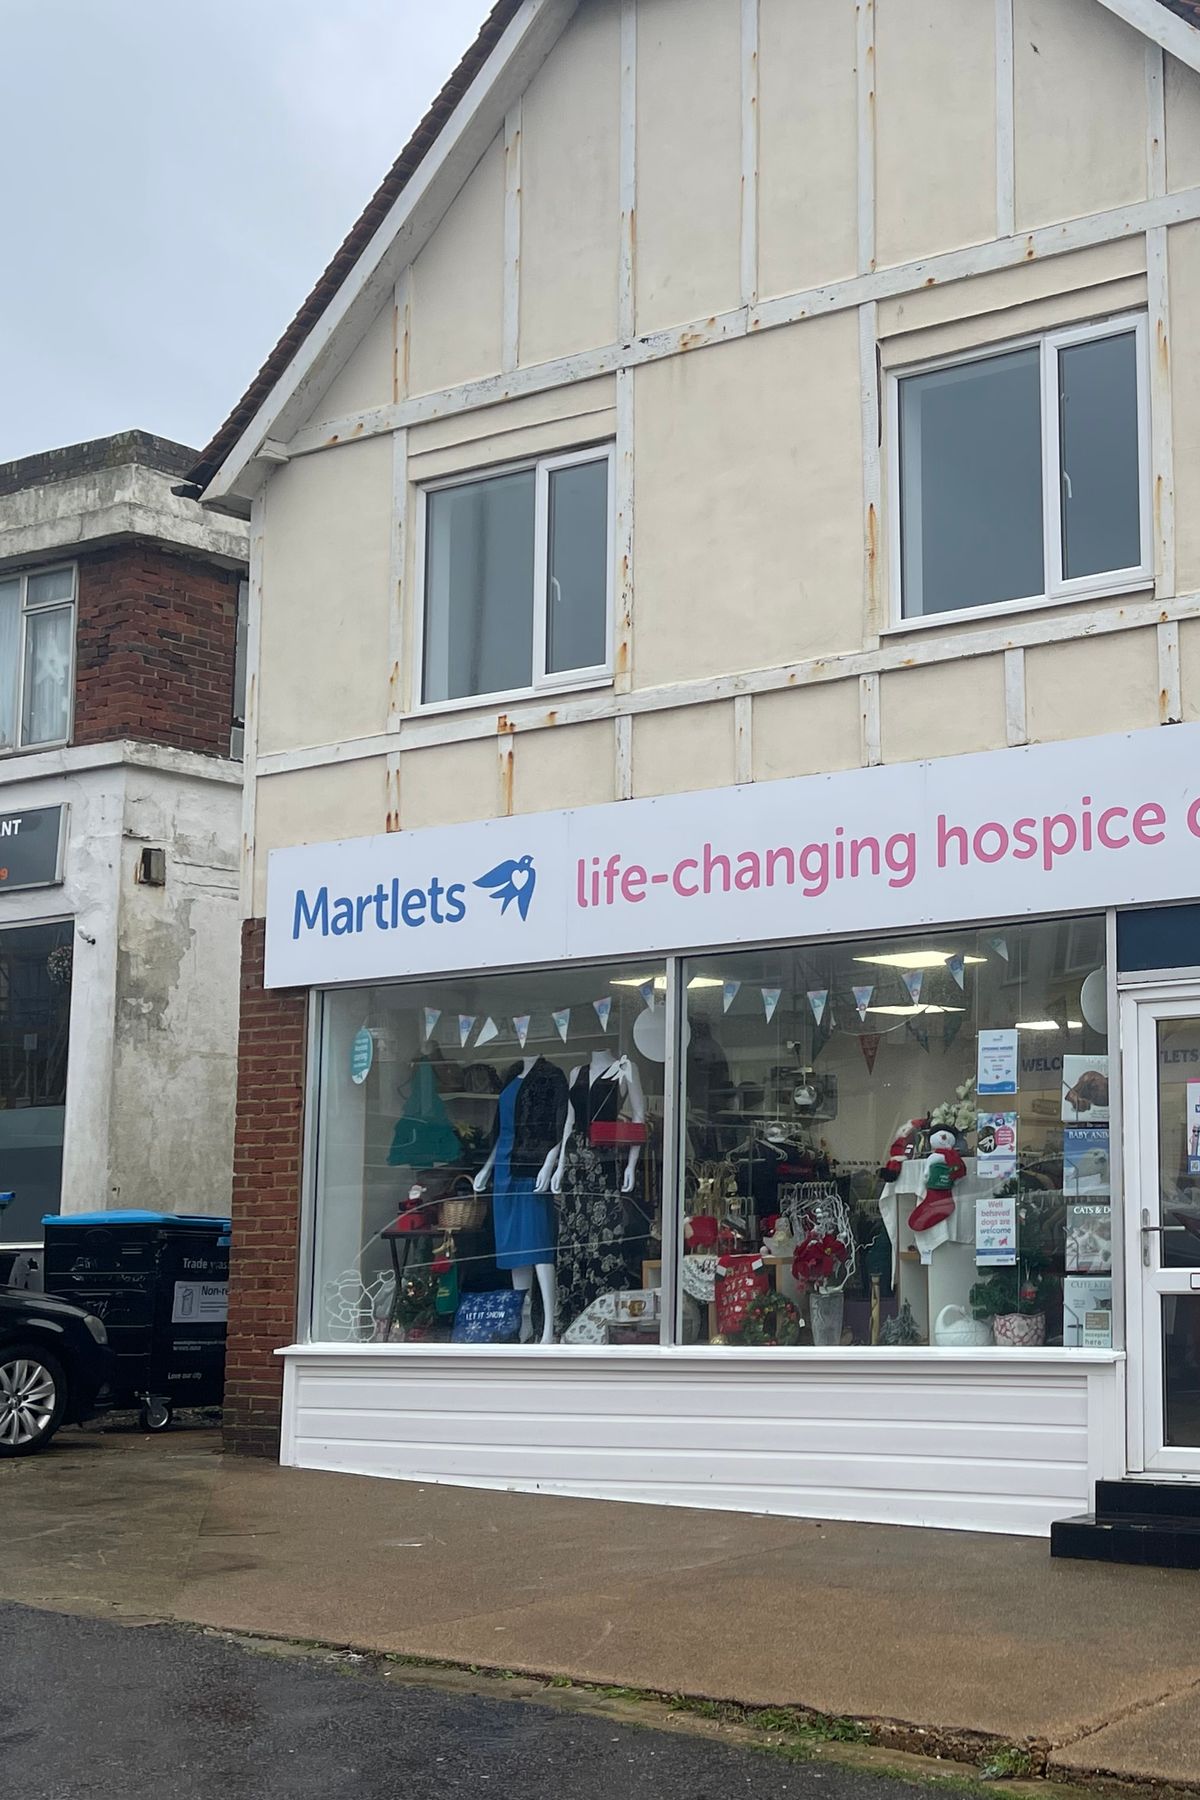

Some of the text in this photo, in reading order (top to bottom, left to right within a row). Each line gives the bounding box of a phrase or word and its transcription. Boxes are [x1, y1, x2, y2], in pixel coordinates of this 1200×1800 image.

[0, 818, 22, 837] NT
[577, 833, 916, 907] life-changing
[937, 803, 1166, 870] hospice
[292, 877, 466, 941] Martlets
[1160, 1048, 1199, 1064] LETS
[1068, 1130, 1089, 1139] BABY
[988, 1200, 1003, 1208] Well
[981, 1209, 1010, 1217] behaved
[1073, 1206, 1094, 1214] CATS
[1095, 1206, 1102, 1214] &
[183, 1257, 208, 1269] Trade
[466, 1311, 506, 1321] LET IT SNOW
